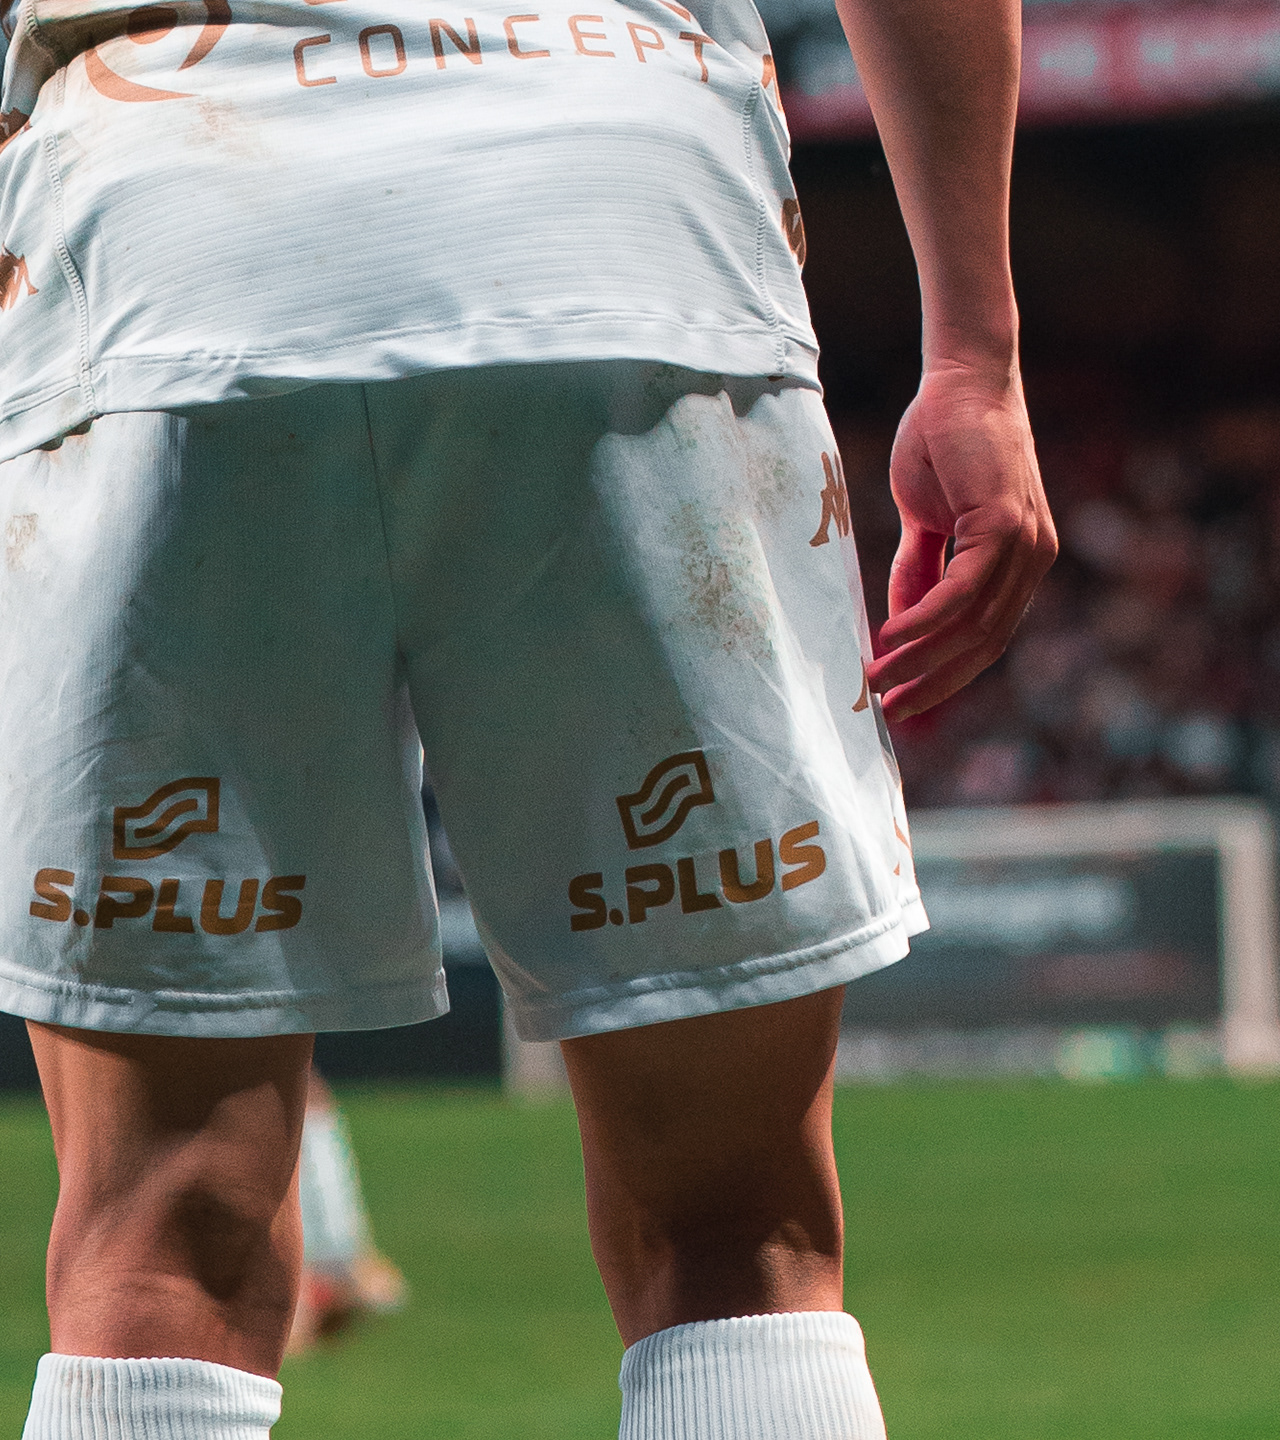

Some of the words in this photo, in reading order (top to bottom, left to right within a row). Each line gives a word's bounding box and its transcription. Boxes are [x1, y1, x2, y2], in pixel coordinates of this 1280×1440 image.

[292, 14, 715, 88] CONCEPT
[28, 867, 308, 936] S.PLUS
[568, 819, 827, 933] S.PLUS
